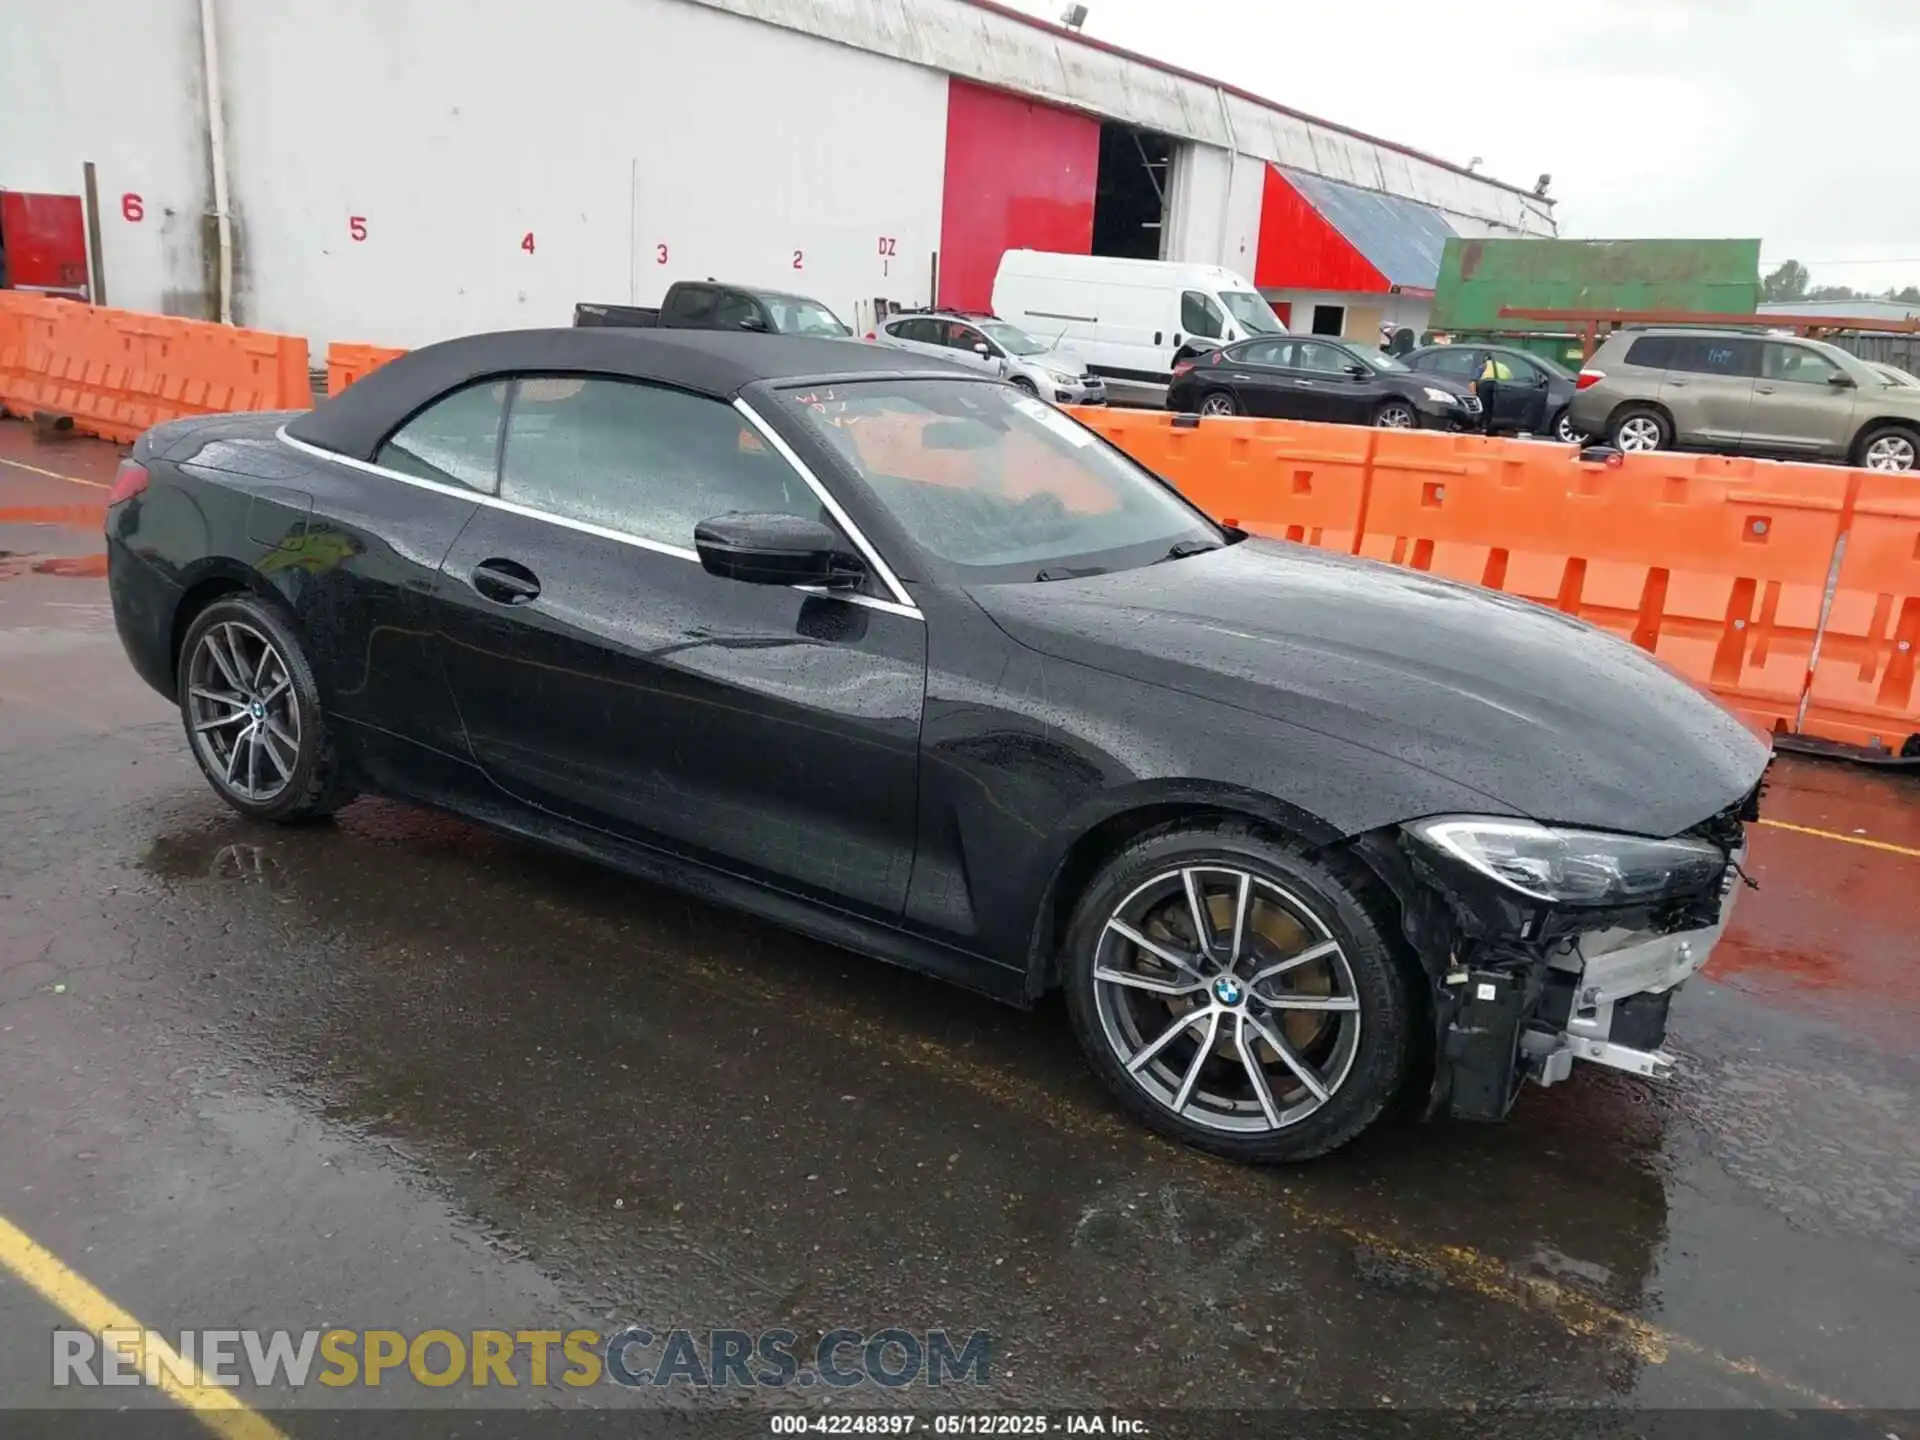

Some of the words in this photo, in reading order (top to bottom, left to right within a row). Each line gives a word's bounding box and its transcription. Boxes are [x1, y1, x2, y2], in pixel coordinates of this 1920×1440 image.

[120, 192, 145, 223] 6
[349, 215, 367, 242] 5
[520, 231, 536, 255] 4
[656, 243, 668, 265] 3
[878, 236, 896, 257] DZ
[792, 250, 803, 270] 2
